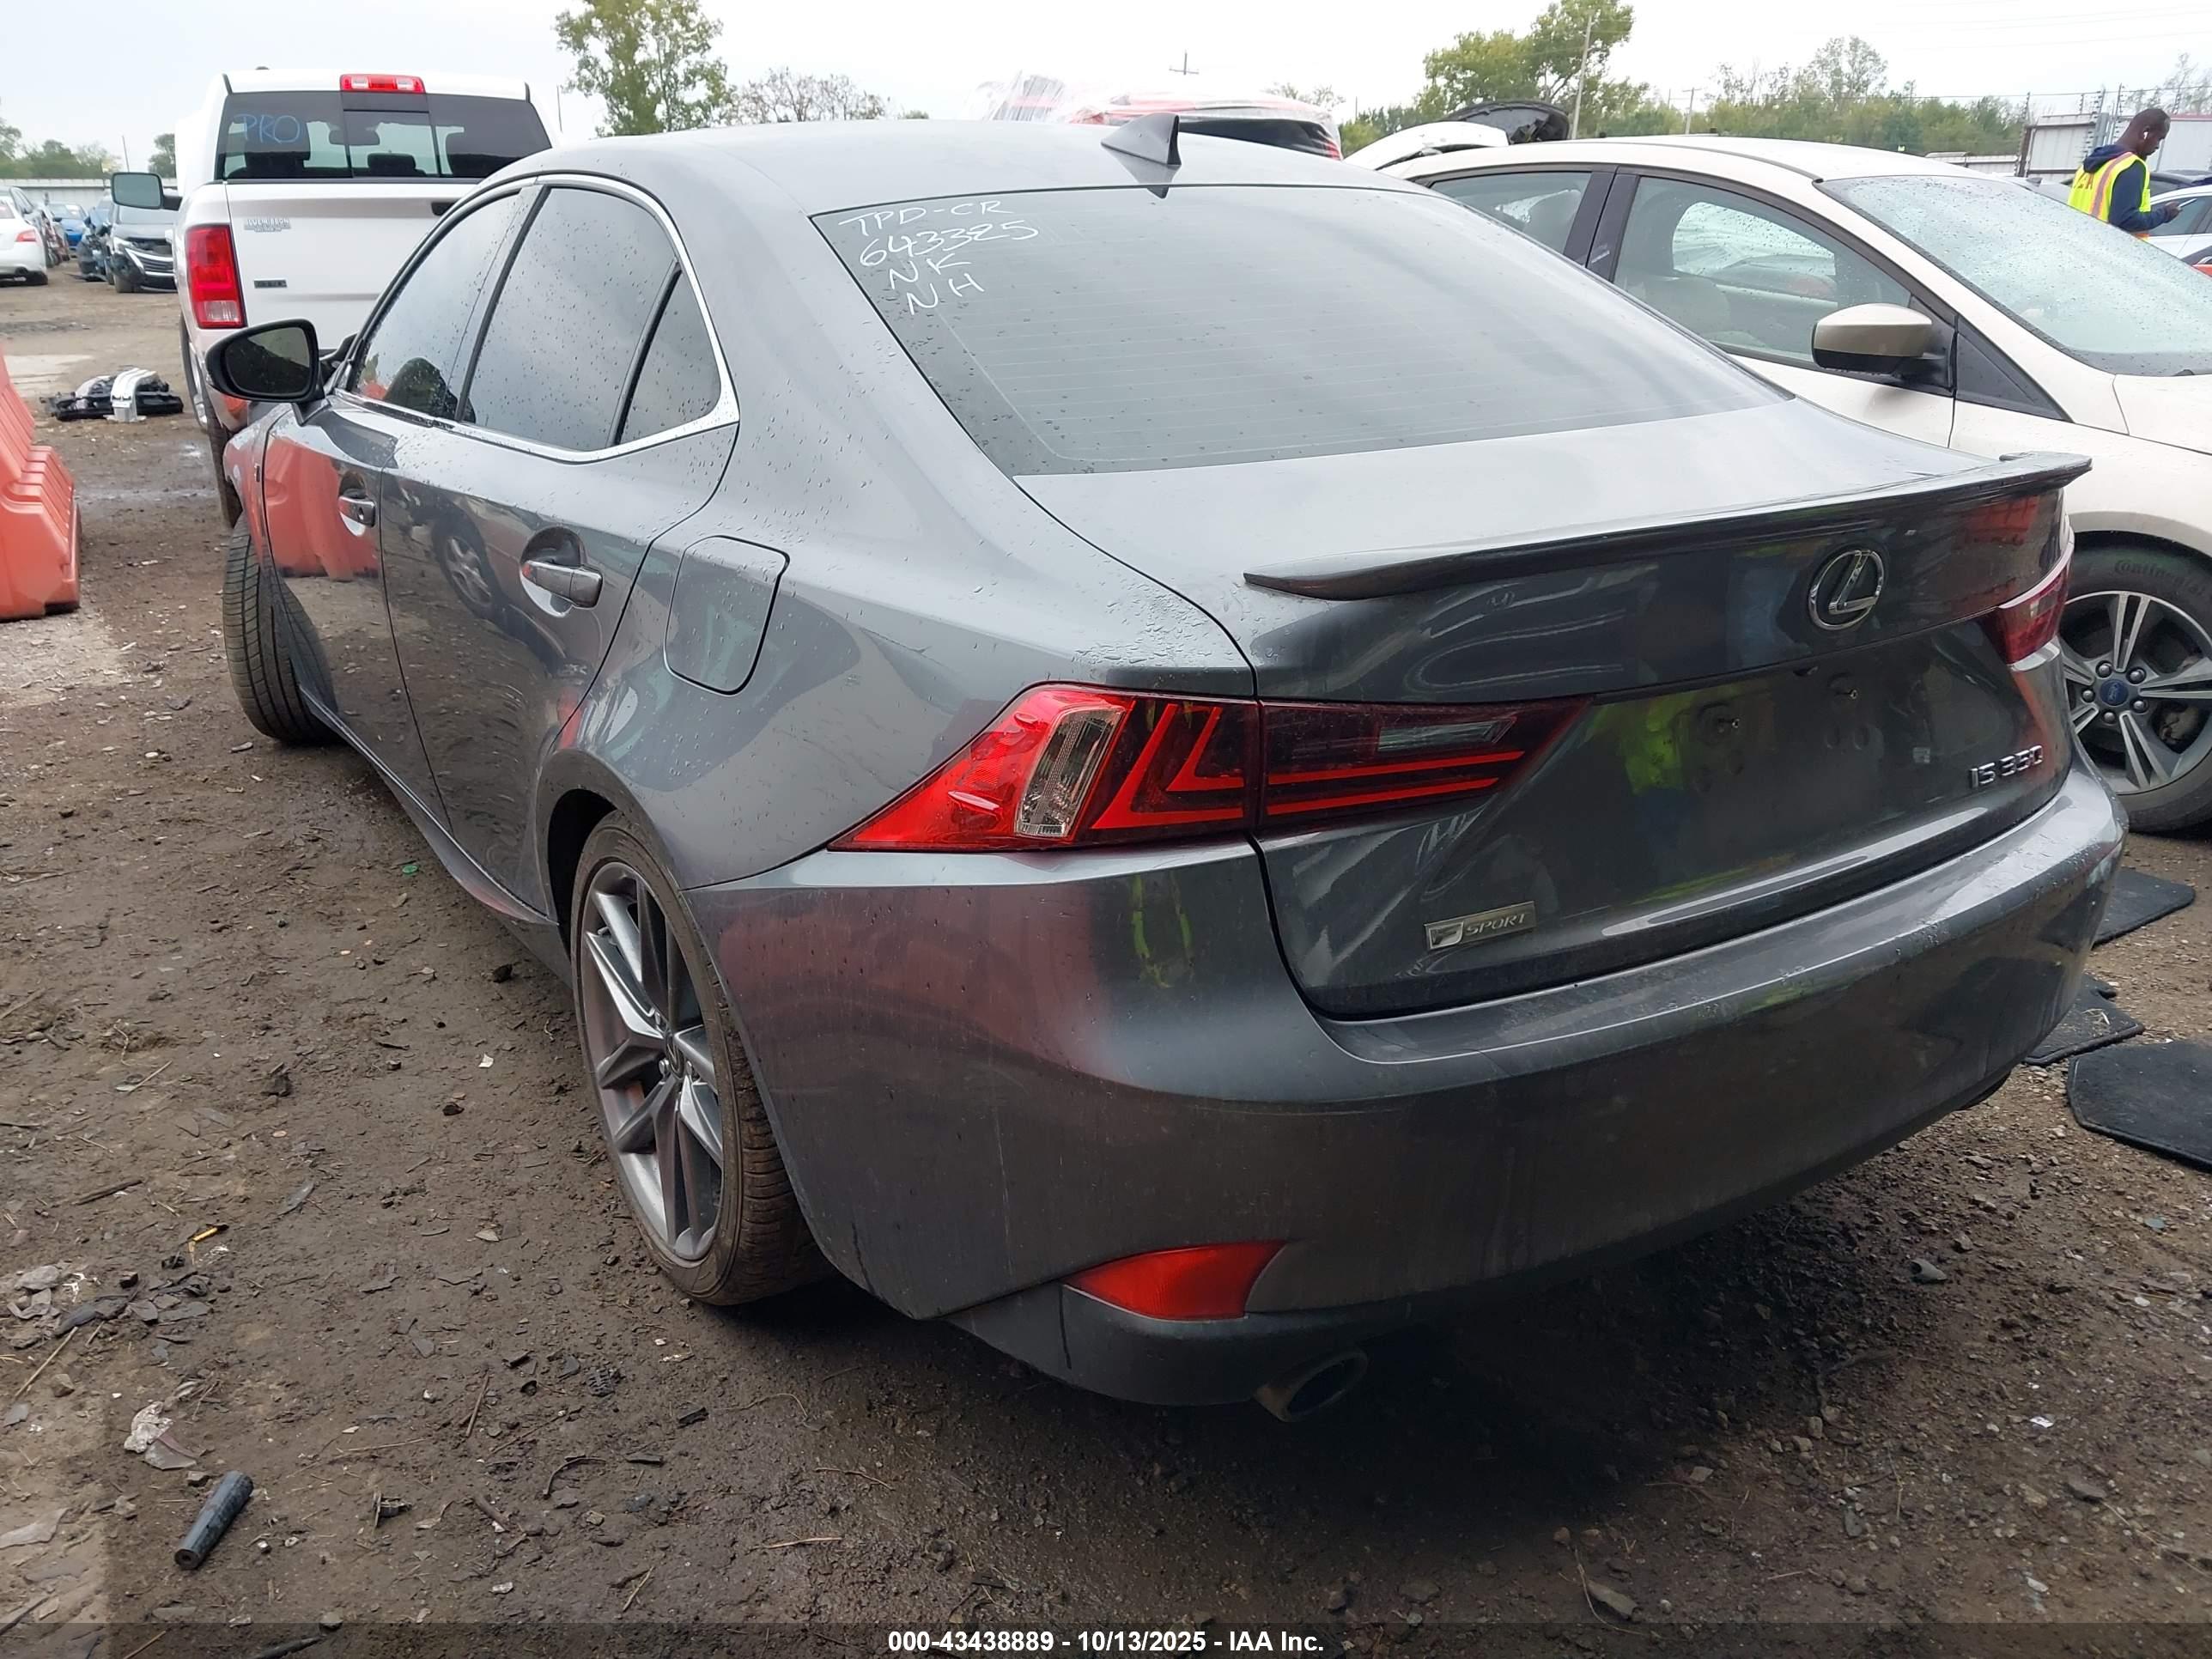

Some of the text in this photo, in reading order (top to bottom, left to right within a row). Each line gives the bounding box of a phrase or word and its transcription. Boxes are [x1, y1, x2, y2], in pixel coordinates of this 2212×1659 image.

[1970, 744, 2045, 789] IS 350
[1466, 913, 1525, 937] SPORT
